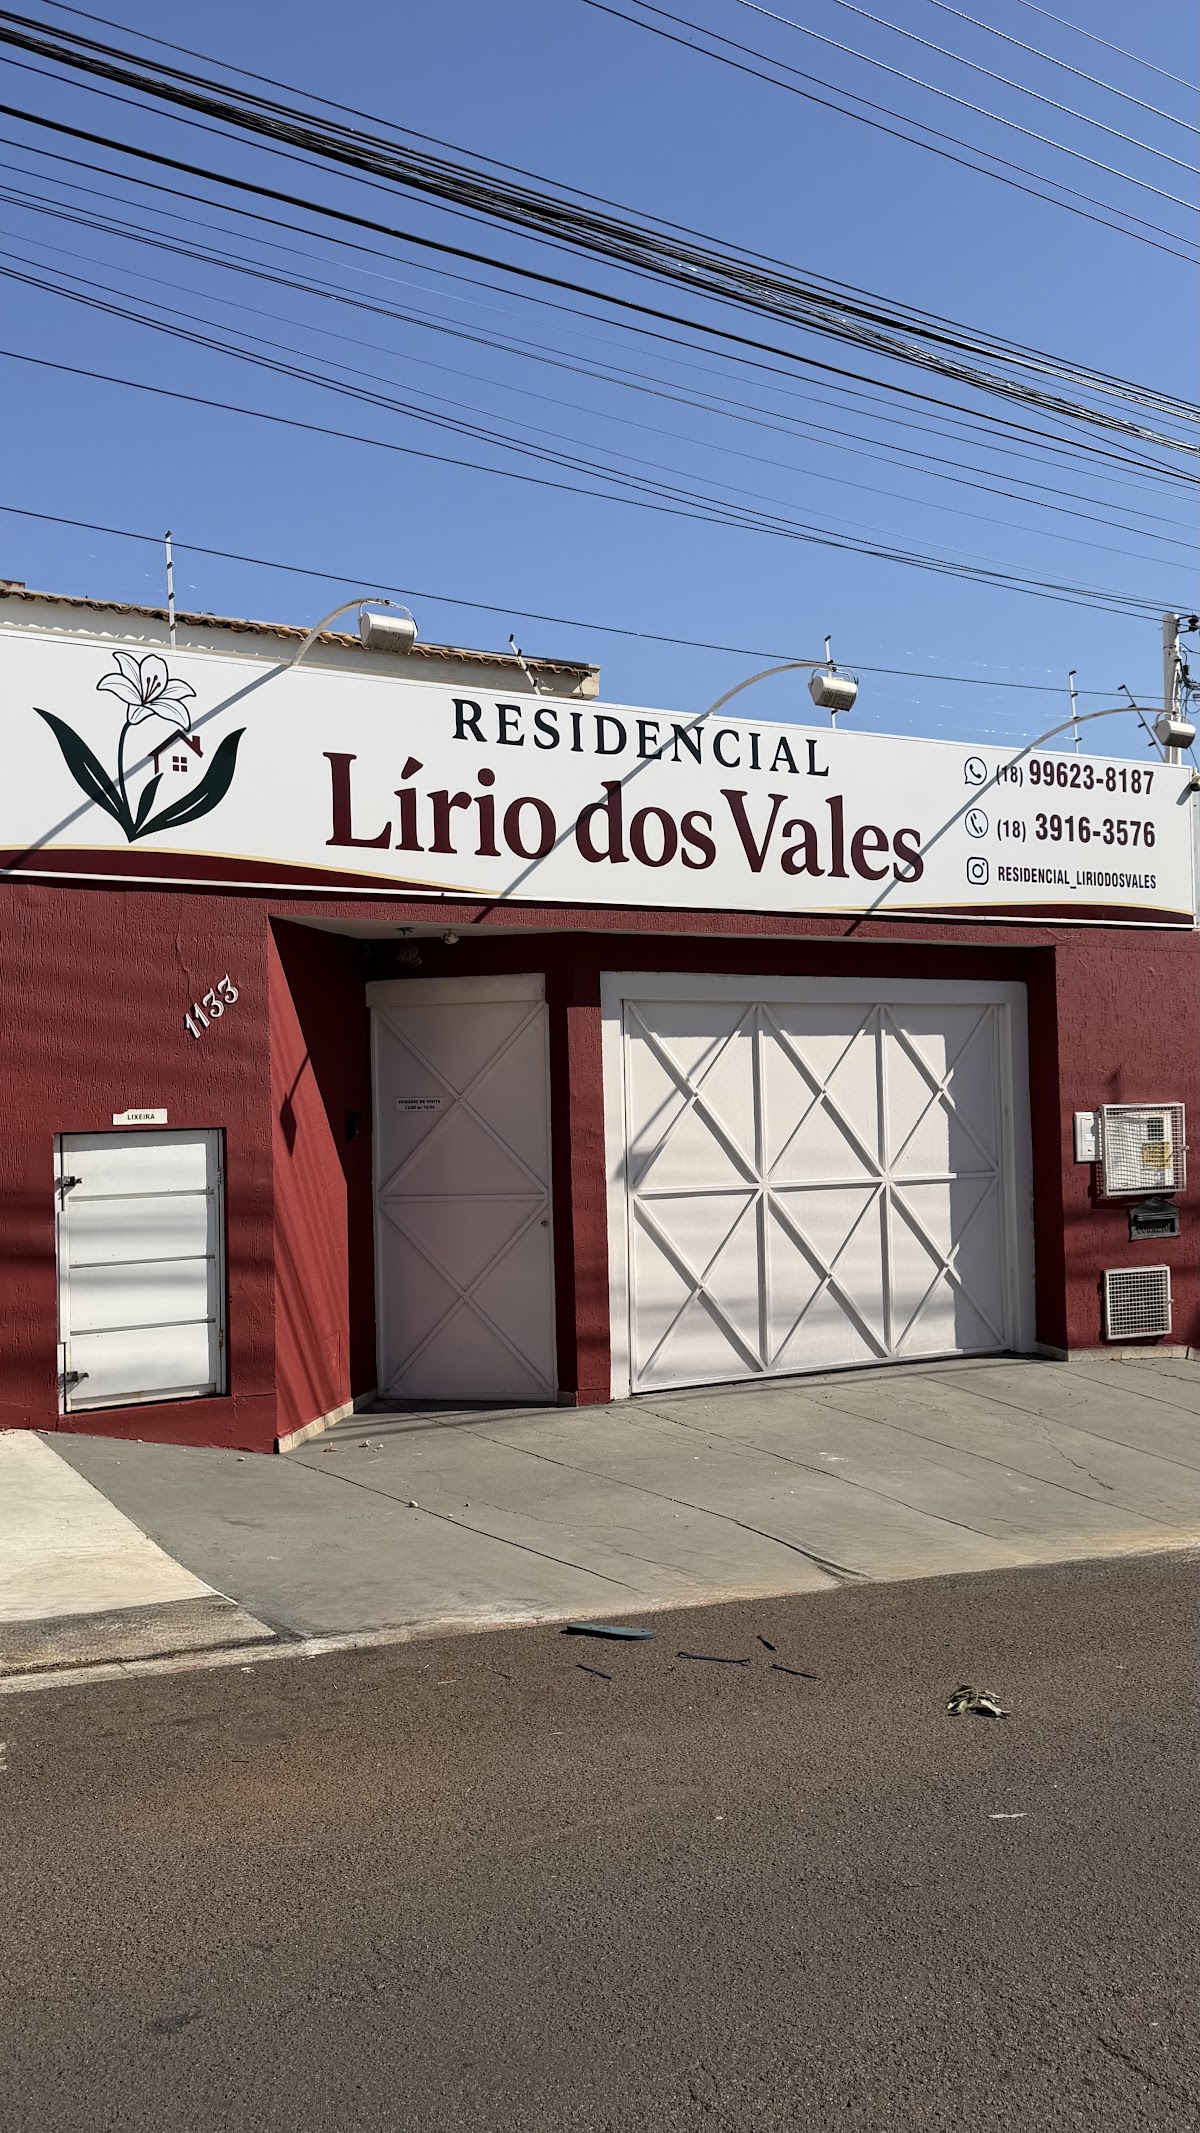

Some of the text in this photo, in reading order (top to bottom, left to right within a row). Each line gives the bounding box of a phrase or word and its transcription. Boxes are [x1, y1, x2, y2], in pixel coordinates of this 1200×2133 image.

[451, 698, 830, 777] RESIDENCIAL
[995, 759, 1155, 795] (18) 99623-8187
[322, 751, 924, 885] Lírio dos Vales
[996, 812, 1156, 848] (18) 3916-3576
[997, 865, 1157, 890] RESIDENCIAL_LIRIODOSVALES
[184, 974, 239, 1039] 1133
[126, 1113, 156, 1121] LIXEIRA
